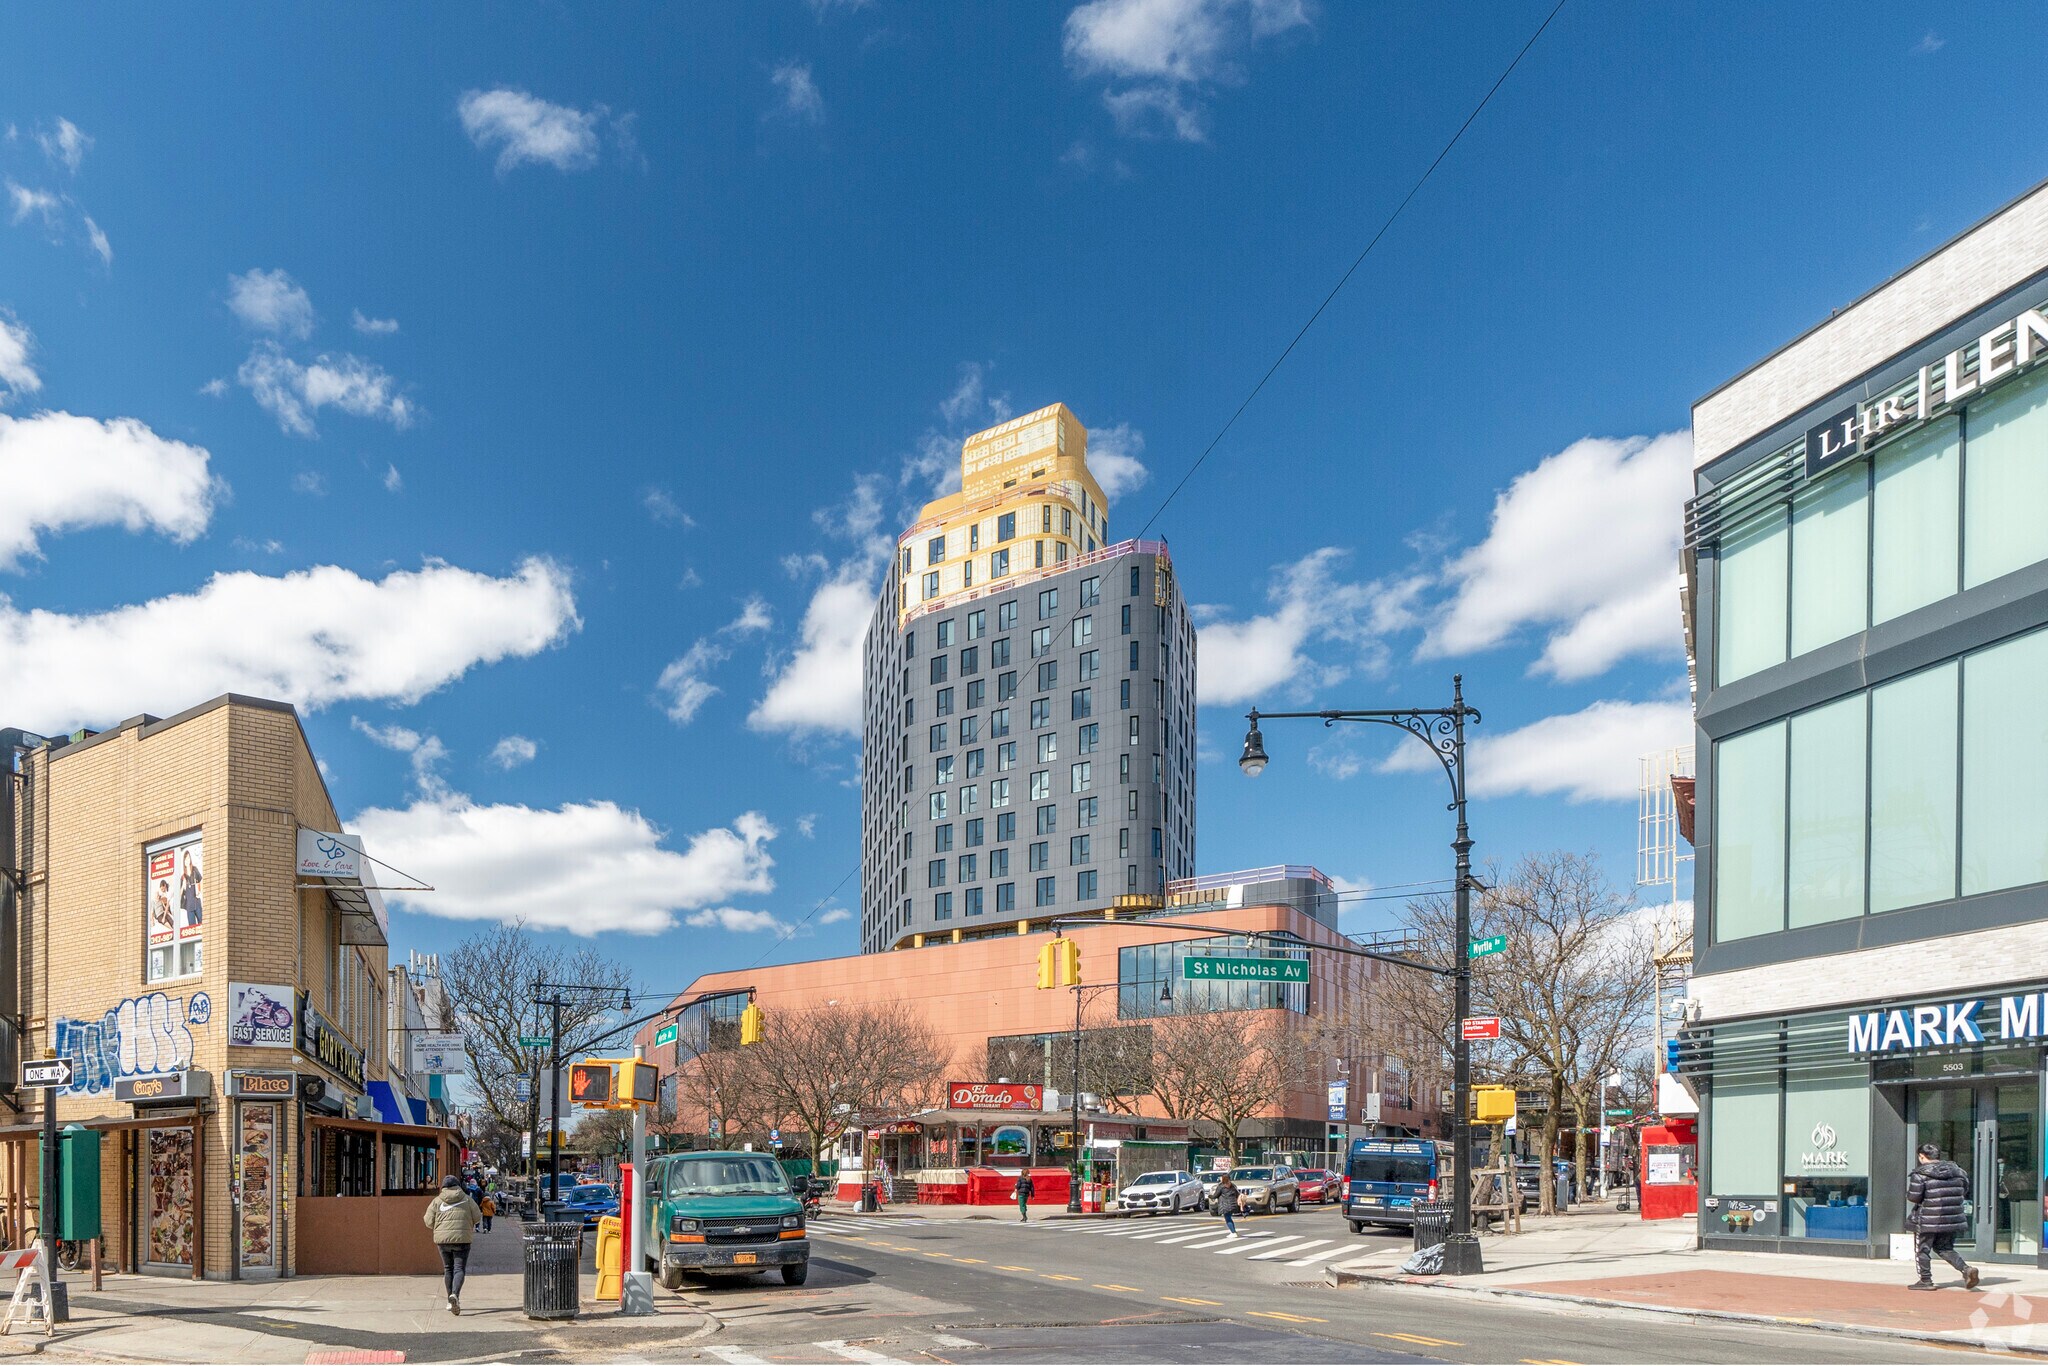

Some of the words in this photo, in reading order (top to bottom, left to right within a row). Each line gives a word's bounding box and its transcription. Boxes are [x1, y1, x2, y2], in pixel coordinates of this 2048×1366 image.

[1818, 396, 1906, 460] LHR
[301, 859, 320, 867] Love
[335, 861, 354, 871] Care
[1473, 941, 1493, 955] Myrtle
[1194, 962, 1209, 975] St
[1216, 962, 1278, 977] Nicholas
[1285, 965, 1301, 977] Av
[233, 1026, 254, 1041] FAST
[255, 1027, 291, 1043] SERVICE
[1849, 1001, 1980, 1053] MARK
[30, 1069, 44, 1079] ONE
[50, 1067, 65, 1078] WAY
[1943, 1063, 1963, 1071] 5503
[133, 1079, 163, 1096] Gory's
[243, 1075, 290, 1092] Place
[972, 1085, 988, 1093] El
[953, 1089, 1012, 1104] Dorado
[1801, 1151, 1848, 1164] MARK
